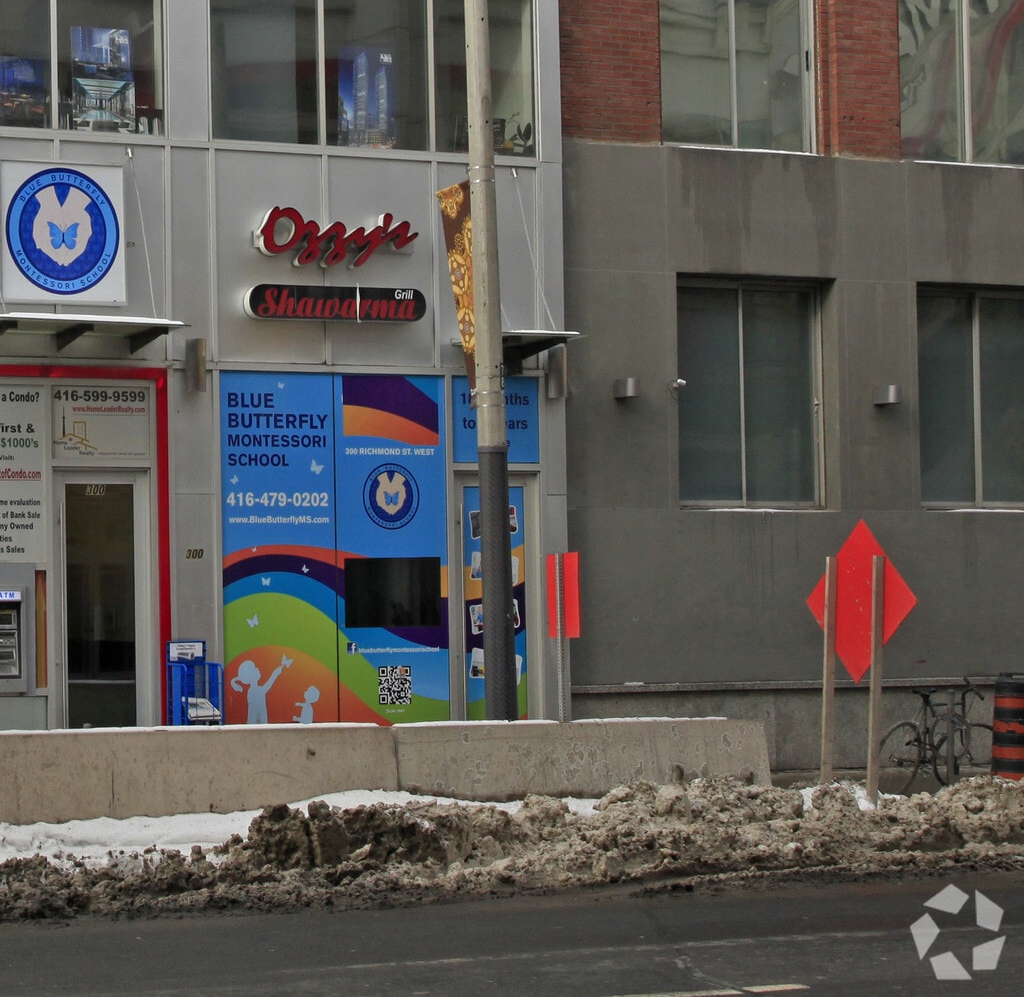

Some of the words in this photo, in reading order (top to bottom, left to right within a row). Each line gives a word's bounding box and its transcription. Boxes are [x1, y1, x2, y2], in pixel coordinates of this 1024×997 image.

[19, 179, 42, 202] BLUE
[51, 174, 106, 206] BUTTERFLY
[259, 206, 419, 268] Ozzy's
[15, 249, 75, 290] MONTESSORI
[80, 252, 111, 286] SCHOOL
[394, 289, 414, 300] Grill
[257, 287, 416, 320] Shawarma
[1, 393, 7, 402] a
[9, 391, 40, 403] Condo?
[53, 389, 145, 403] 416-599-9599
[227, 392, 275, 409] BLUE
[72, 405, 145, 414] www.HomeLeaderRealty.com
[227, 412, 328, 430] BUTTERFLY
[462, 416, 477, 430] to
[26, 423, 35, 433] &
[0, 437, 39, 448] $1000's
[228, 434, 327, 448] MONTESSORI
[345, 447, 358, 455] 300
[359, 447, 401, 455] RICHMOND
[402, 448, 413, 456] ST.
[414, 448, 435, 456] WEST
[227, 453, 289, 467] SCHOOL
[86, 484, 106, 495] 300
[9, 498, 41, 506] evaluation
[226, 491, 329, 507] 416-479-0202
[2, 511, 9, 519] of
[10, 511, 26, 519] Bank
[27, 511, 41, 519] Sale
[228, 515, 330, 525] www.BlueButterflyMS.com
[9, 522, 34, 530] Owned
[6, 545, 25, 554] Sales
[185, 548, 204, 560] 300
